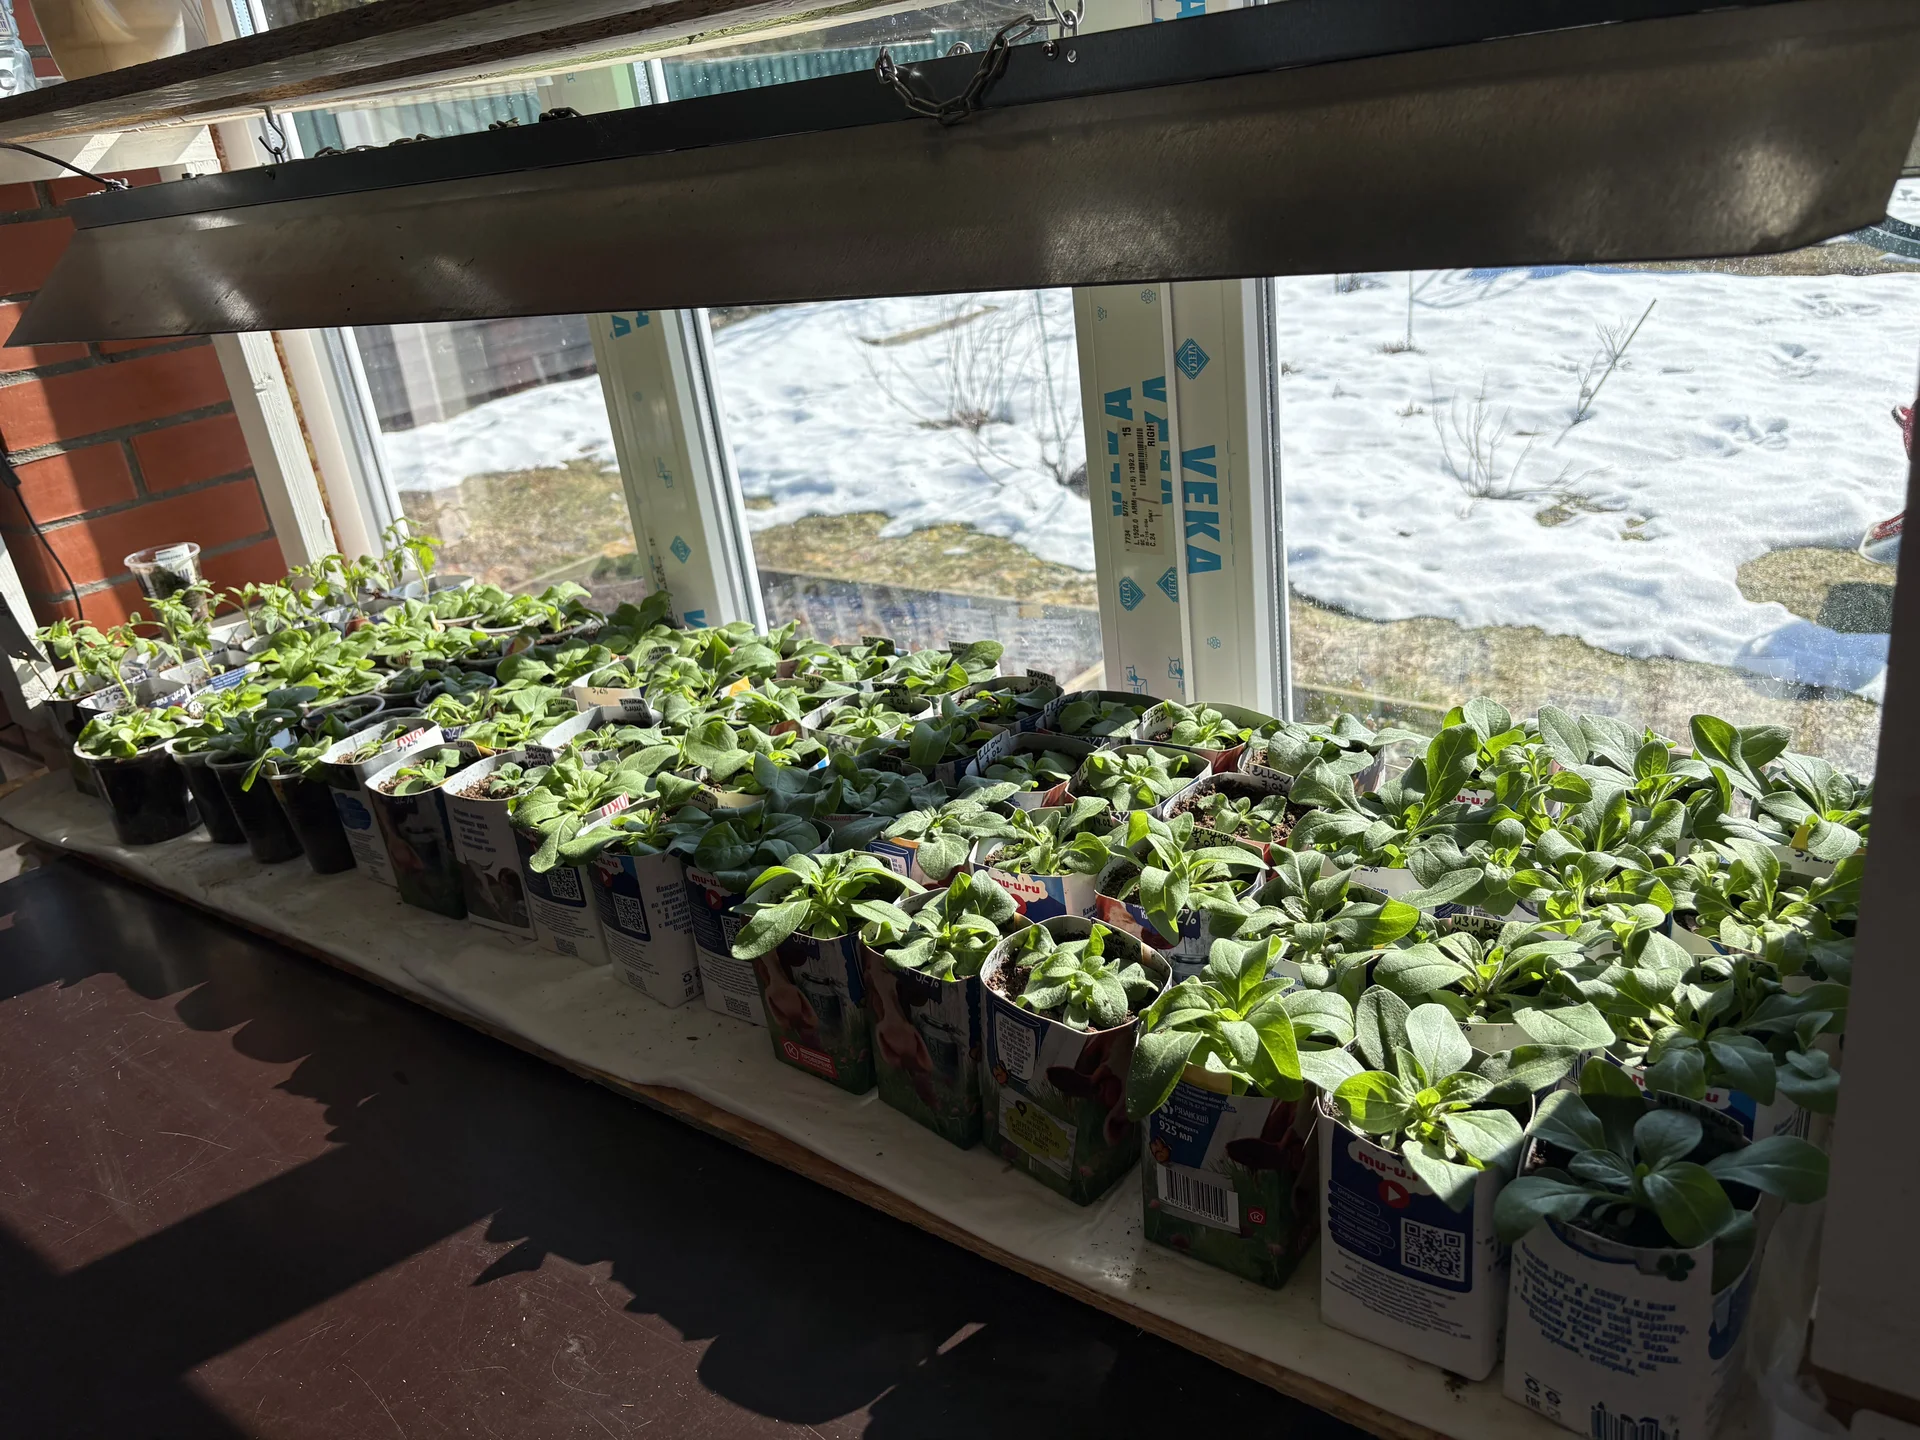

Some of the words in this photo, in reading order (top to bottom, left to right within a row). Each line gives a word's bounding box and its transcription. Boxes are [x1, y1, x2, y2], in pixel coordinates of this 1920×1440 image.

[1188, 344, 1198, 372] VEKA
[1122, 427, 1131, 437] 15
[1181, 444, 1221, 574] VEKA
[1122, 581, 1132, 607] VEKA
[1159, 1120, 1178, 1136] 925
[1179, 1131, 1193, 1143] мл
[1552, 1268, 1577, 1286] утро
[1574, 1286, 1583, 1298] Я
[1622, 1307, 1666, 1322] каждую
